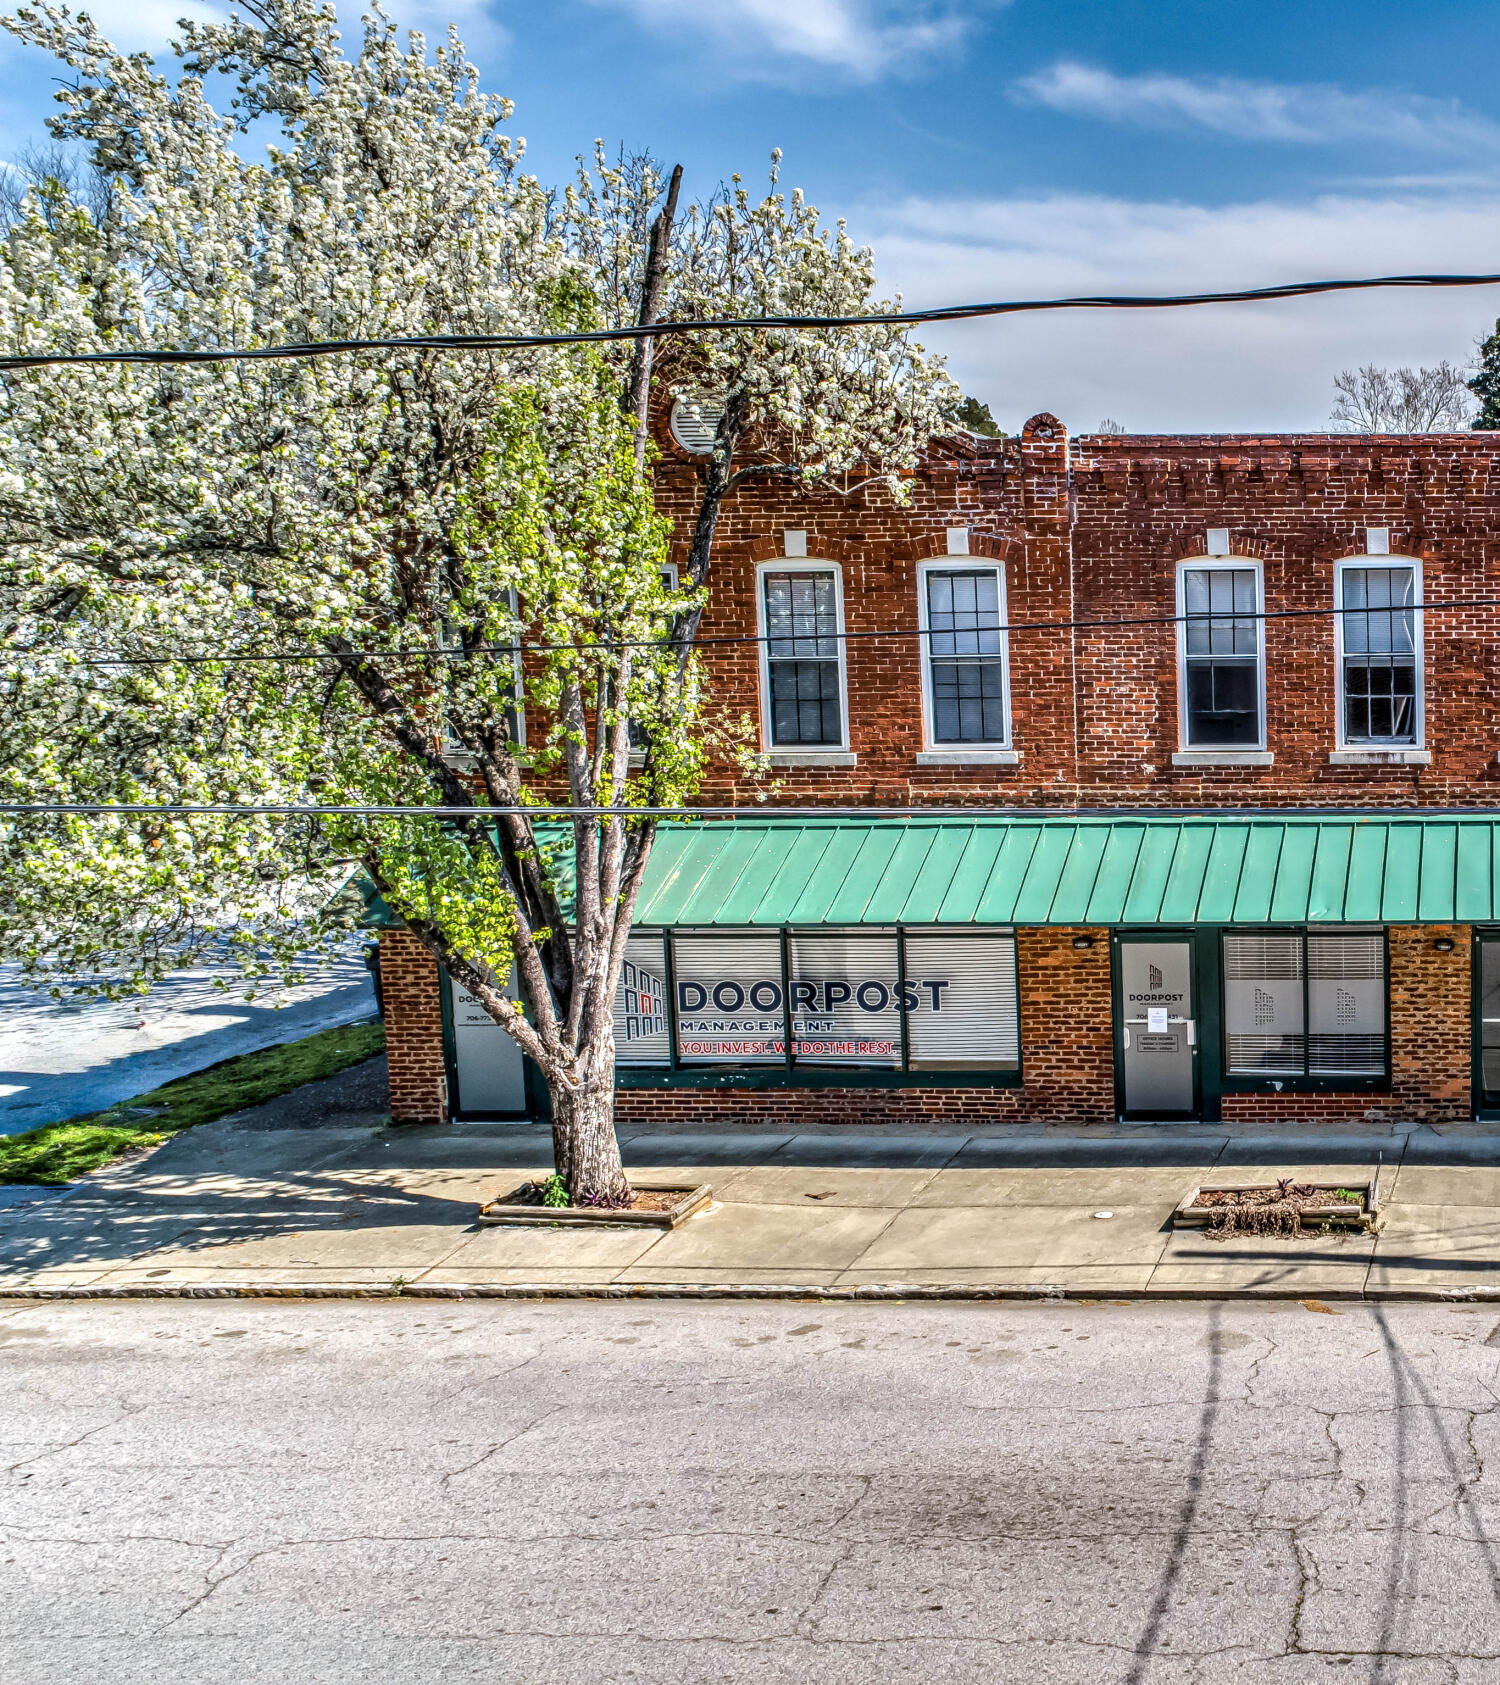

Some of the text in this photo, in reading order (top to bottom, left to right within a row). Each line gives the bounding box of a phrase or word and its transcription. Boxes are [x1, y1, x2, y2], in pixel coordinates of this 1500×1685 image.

[677, 979, 949, 1014] DOORPOST
[679, 1020, 835, 1033] MANAGEMENT
[681, 1041, 897, 1055] YOU INVEST. WE DO THE REST.
